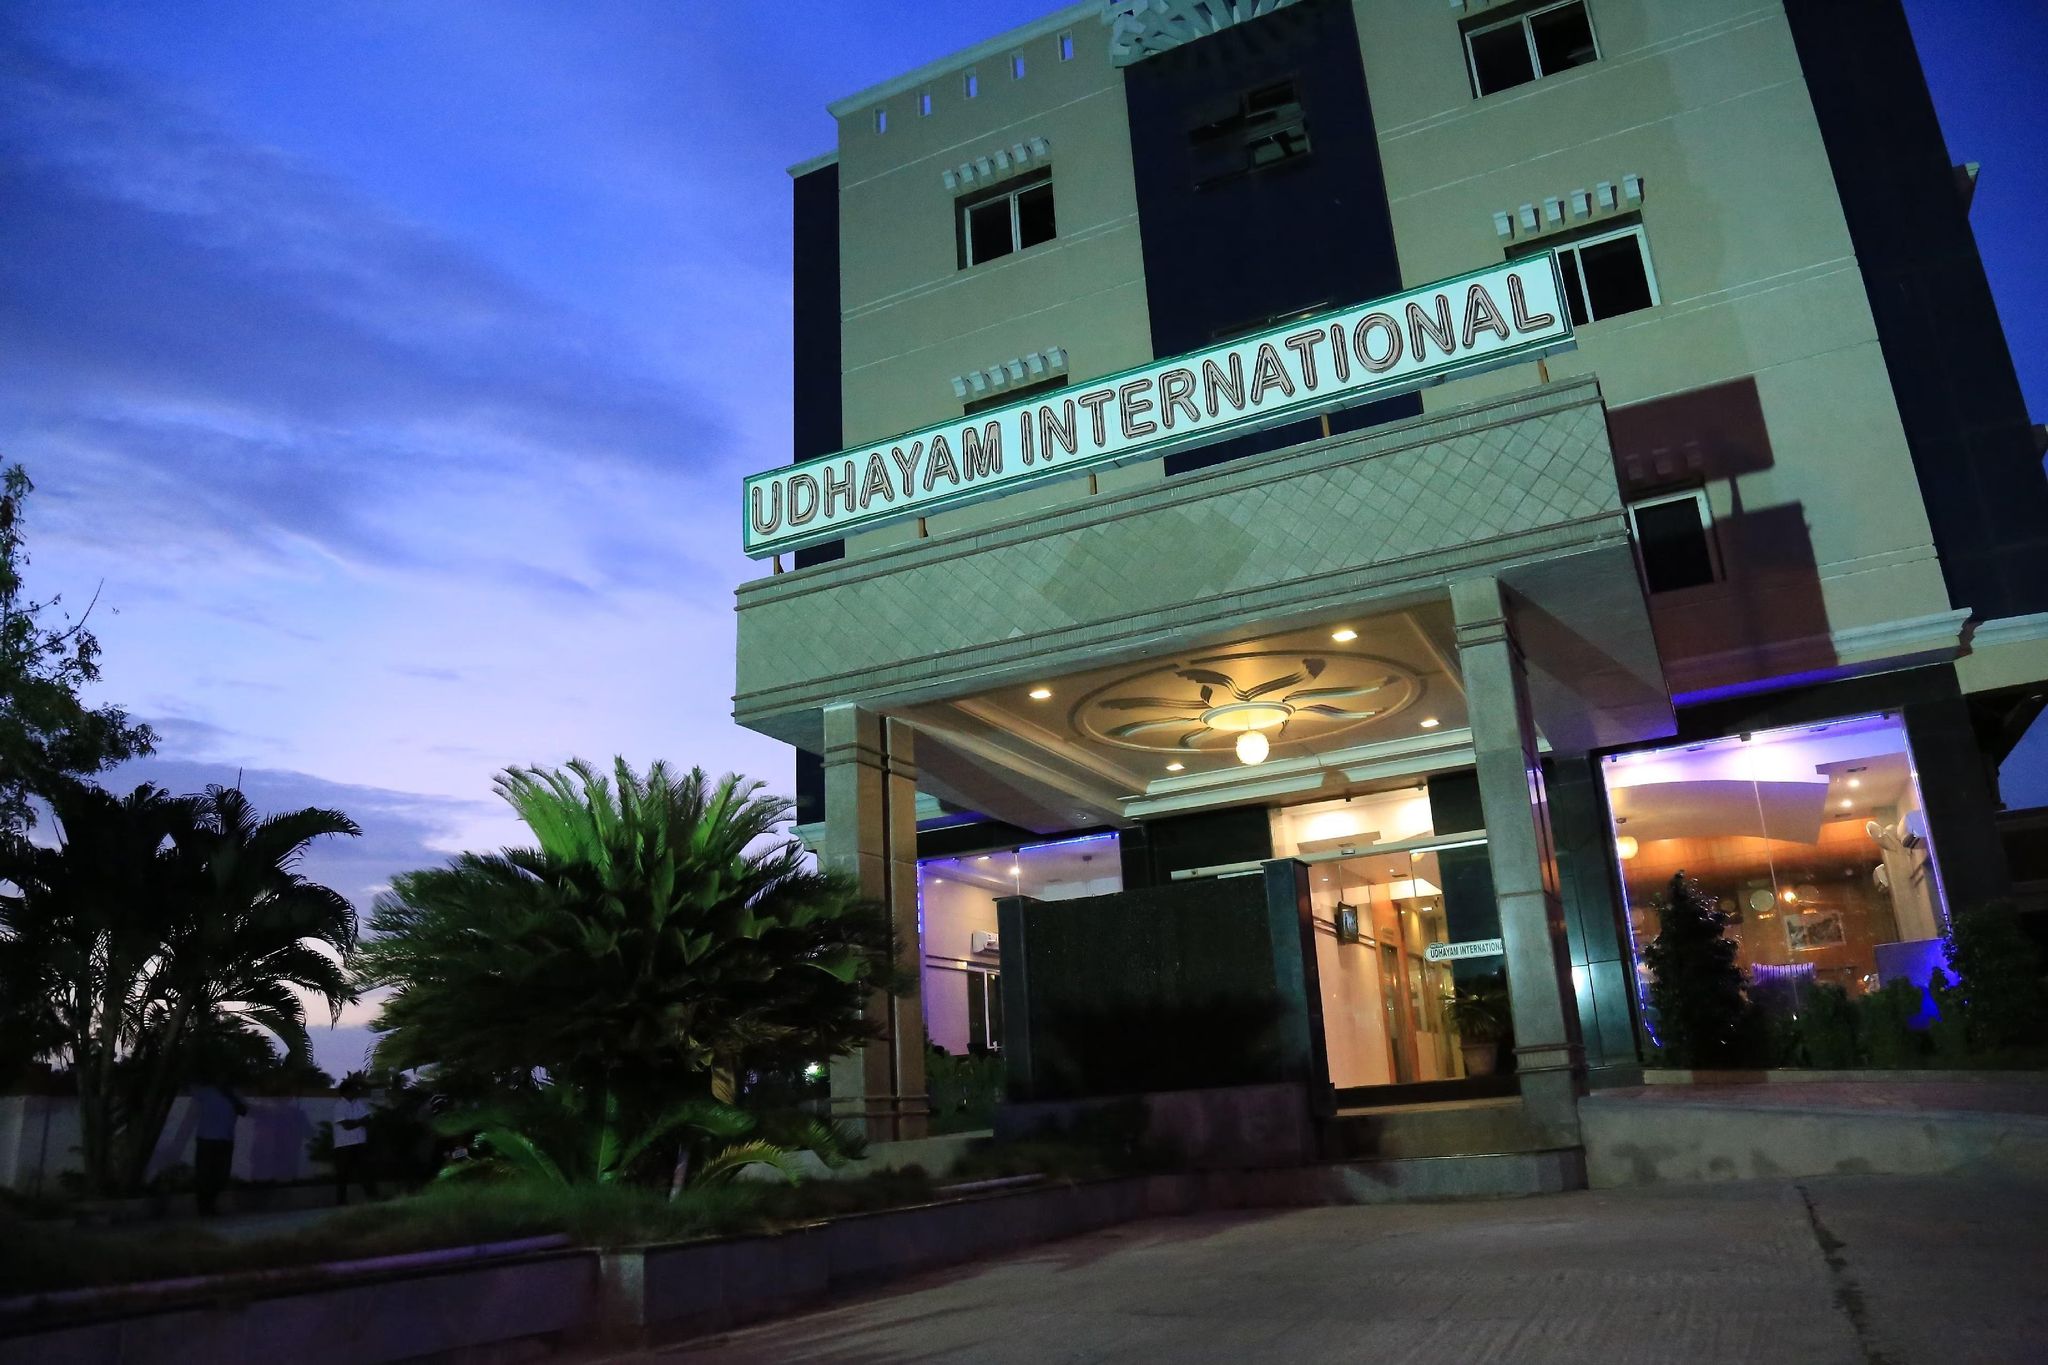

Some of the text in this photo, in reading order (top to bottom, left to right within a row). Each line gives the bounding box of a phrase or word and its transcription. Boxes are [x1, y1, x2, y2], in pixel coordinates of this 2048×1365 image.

[752, 273, 1555, 536] UDHAYAM INTERNATIONAL
[1430, 946, 1458, 958] UDHAYAM
